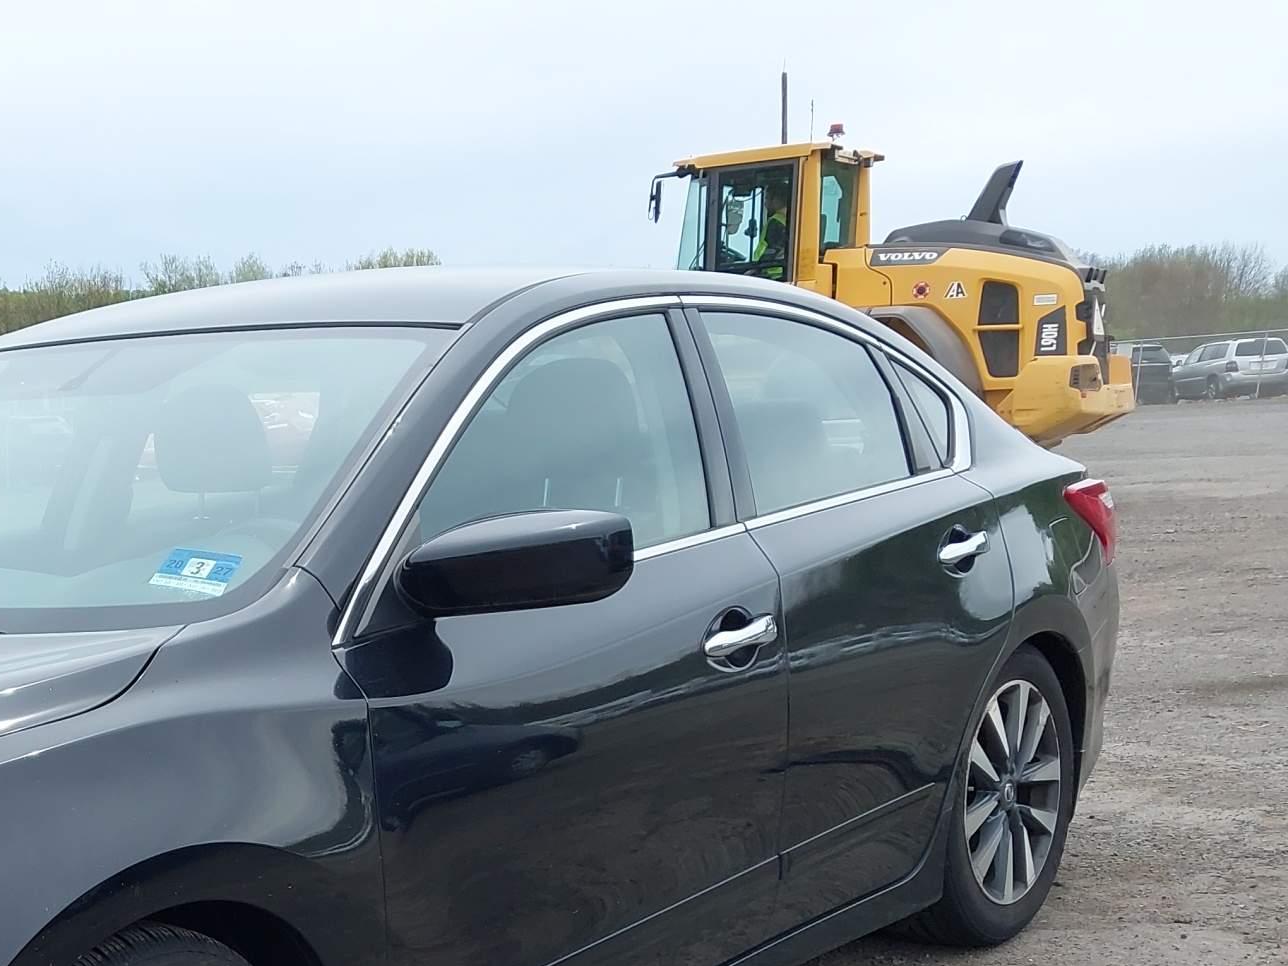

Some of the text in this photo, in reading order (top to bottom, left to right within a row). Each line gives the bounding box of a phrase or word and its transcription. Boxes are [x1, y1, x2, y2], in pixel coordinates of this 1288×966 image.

[878, 252, 938, 261] VOLVO
[1040, 323, 1059, 352] L90H
[190, 561, 205, 574] 3
[214, 566, 233, 576] 27
